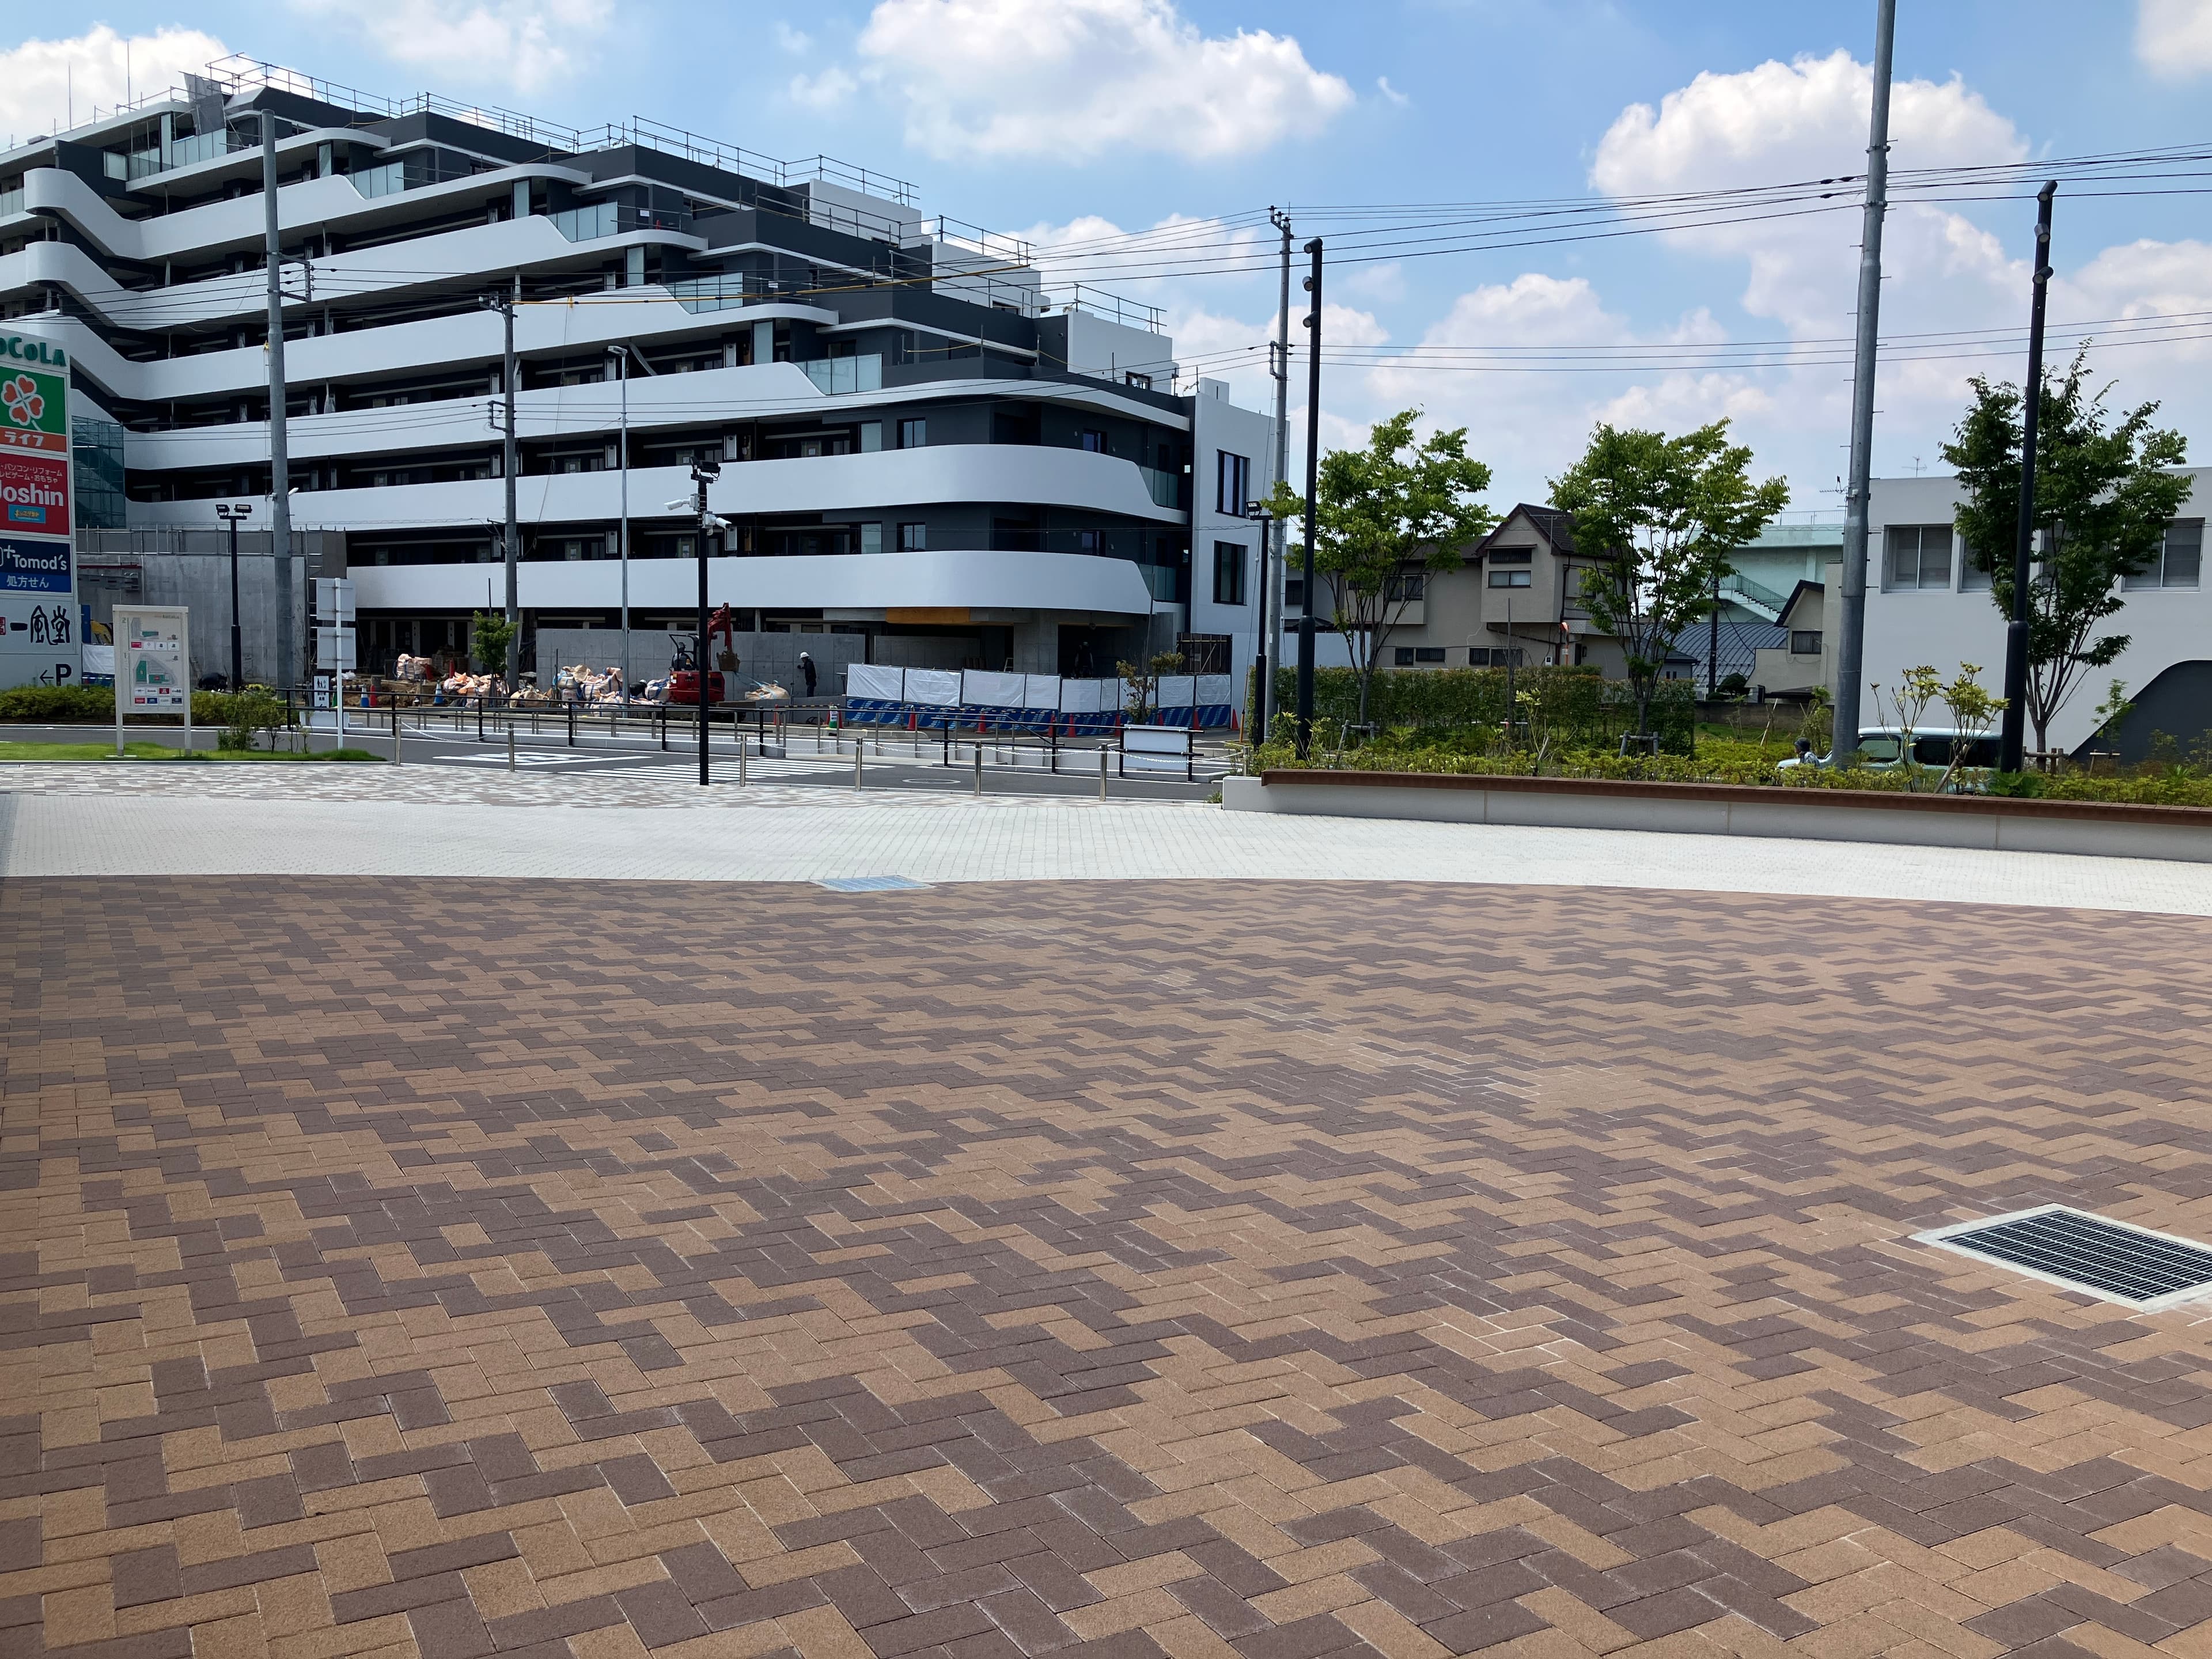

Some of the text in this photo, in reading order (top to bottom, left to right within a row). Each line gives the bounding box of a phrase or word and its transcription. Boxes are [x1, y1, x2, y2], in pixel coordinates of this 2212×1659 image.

[5, 431, 44, 447] ライフ
[0, 479, 64, 506] oshin
[12, 554, 67, 570] Tomod's
[6, 575, 49, 588] 処方せん
[10, 605, 70, 645] 一風堂
[55, 664, 72, 686] P
